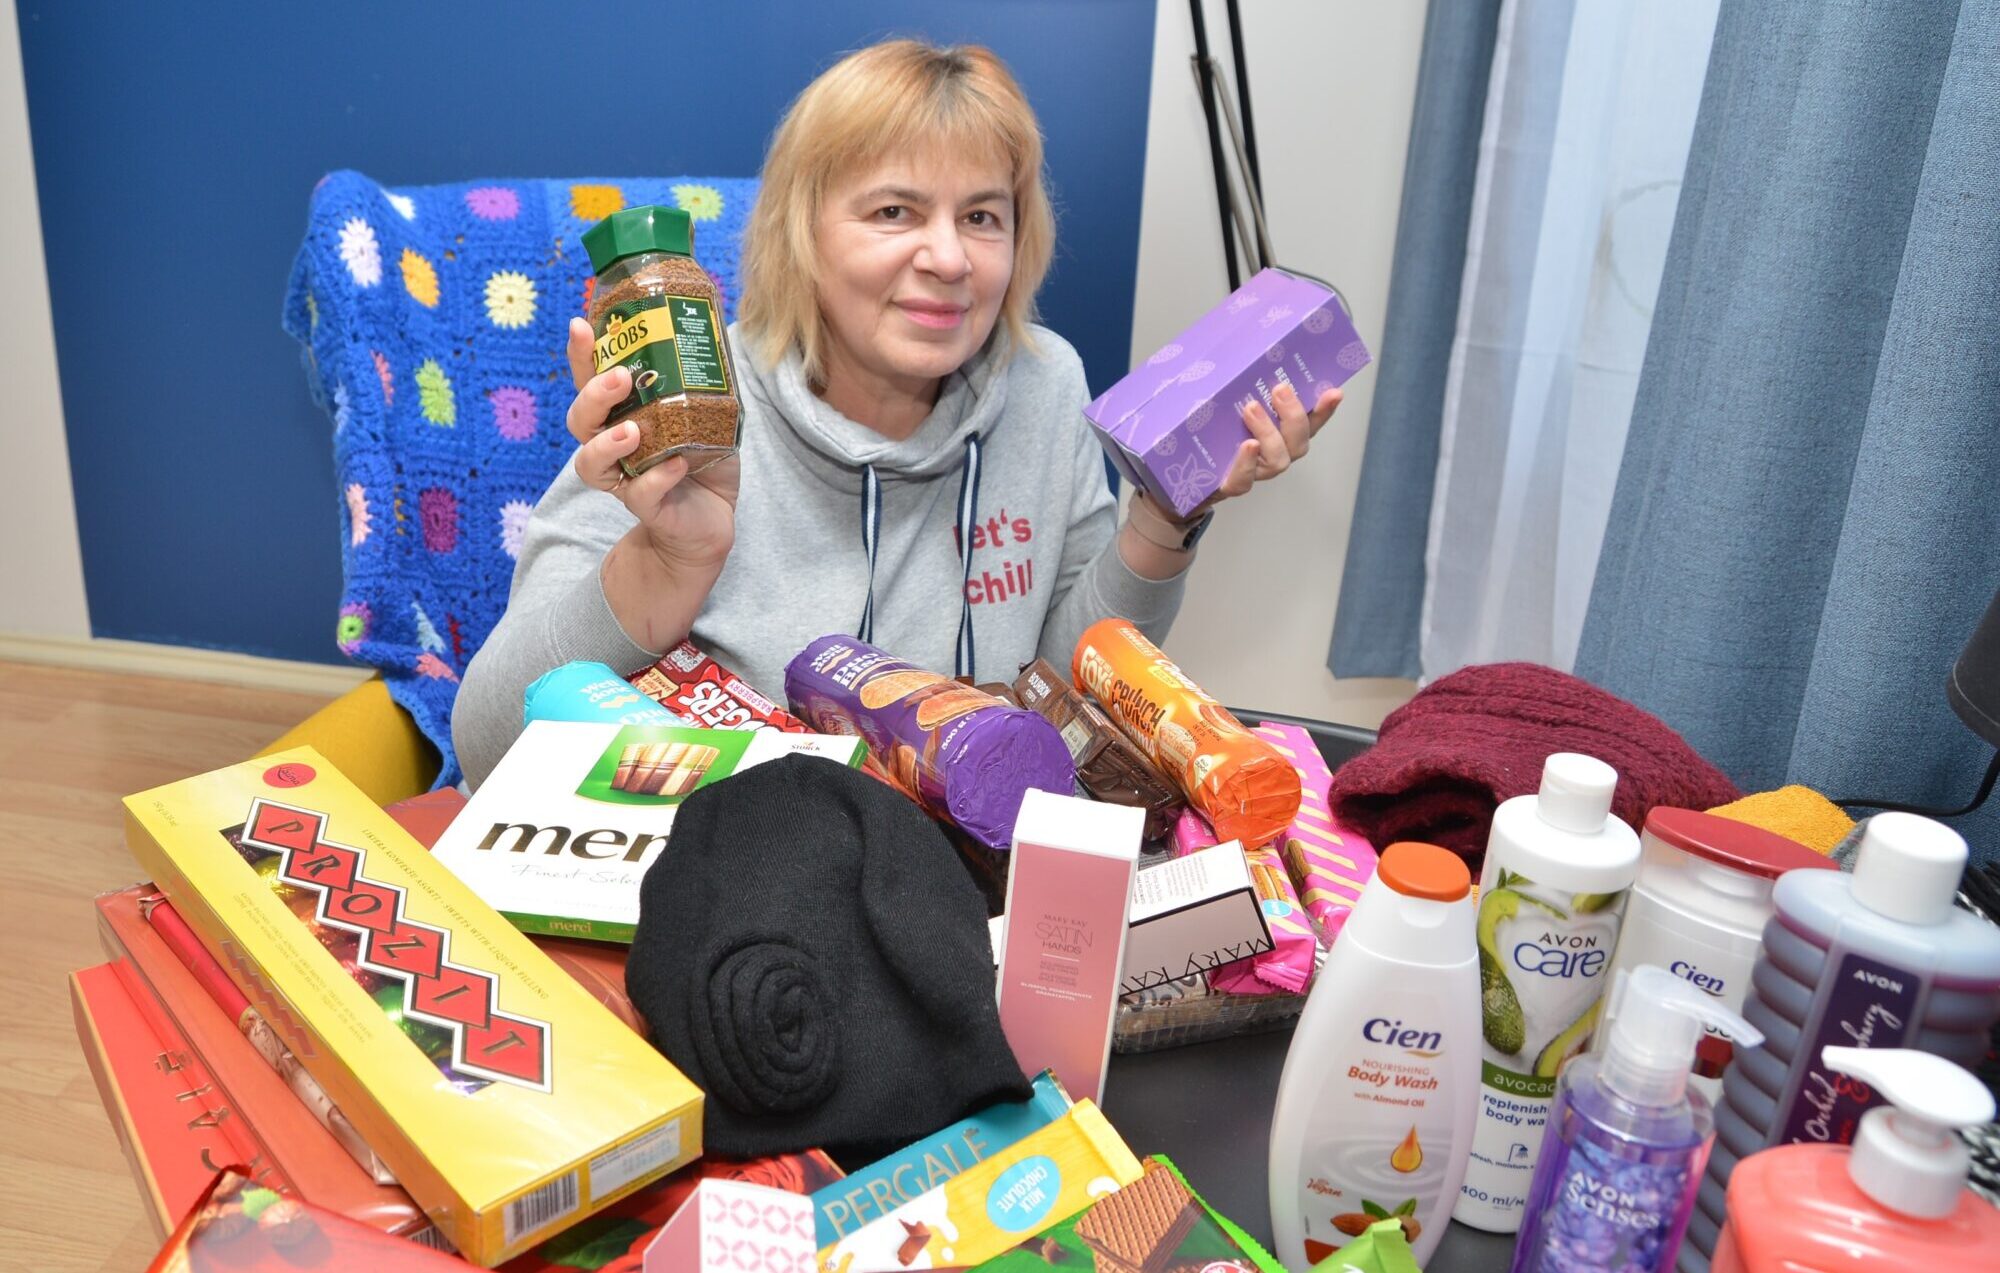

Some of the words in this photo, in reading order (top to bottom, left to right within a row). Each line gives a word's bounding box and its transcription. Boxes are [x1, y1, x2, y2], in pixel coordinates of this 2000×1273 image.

[593, 319, 649, 371] JACOBS
[962, 559, 1033, 605] chill
[728, 681, 774, 712] RASPBERRY
[476, 822, 669, 863] mer
[583, 867, 641, 886] Selec
[548, 918, 593, 935] merci
[1034, 921, 1093, 947] SATIN
[1539, 931, 1598, 949] AVON
[488, 943, 518, 973] LIQUOR
[1042, 939, 1082, 955] HANDS
[1184, 937, 1273, 974] MARY
[1670, 960, 1725, 993] Cien
[1852, 968, 1904, 995] AVON
[1363, 1018, 1442, 1050] Cien
[1840, 1002, 1903, 1049] berry
[1347, 1066, 1390, 1087] Body
[1394, 1075, 1438, 1090] Wash
[1362, 1058, 1430, 1076] NOURISHING
[1354, 1091, 1372, 1100] with
[1372, 1094, 1409, 1107] Almond
[1410, 1098, 1425, 1108] Oil
[1483, 1094, 1551, 1115] replenish
[1485, 1106, 1523, 1127] body
[1527, 1115, 1545, 1127] wa
[997, 1165, 1049, 1213] CHOCOLATE
[1021, 1187, 1046, 1214] MILK
[1306, 1178, 1343, 1198] Vegan
[1570, 1170, 1637, 1208] AVON
